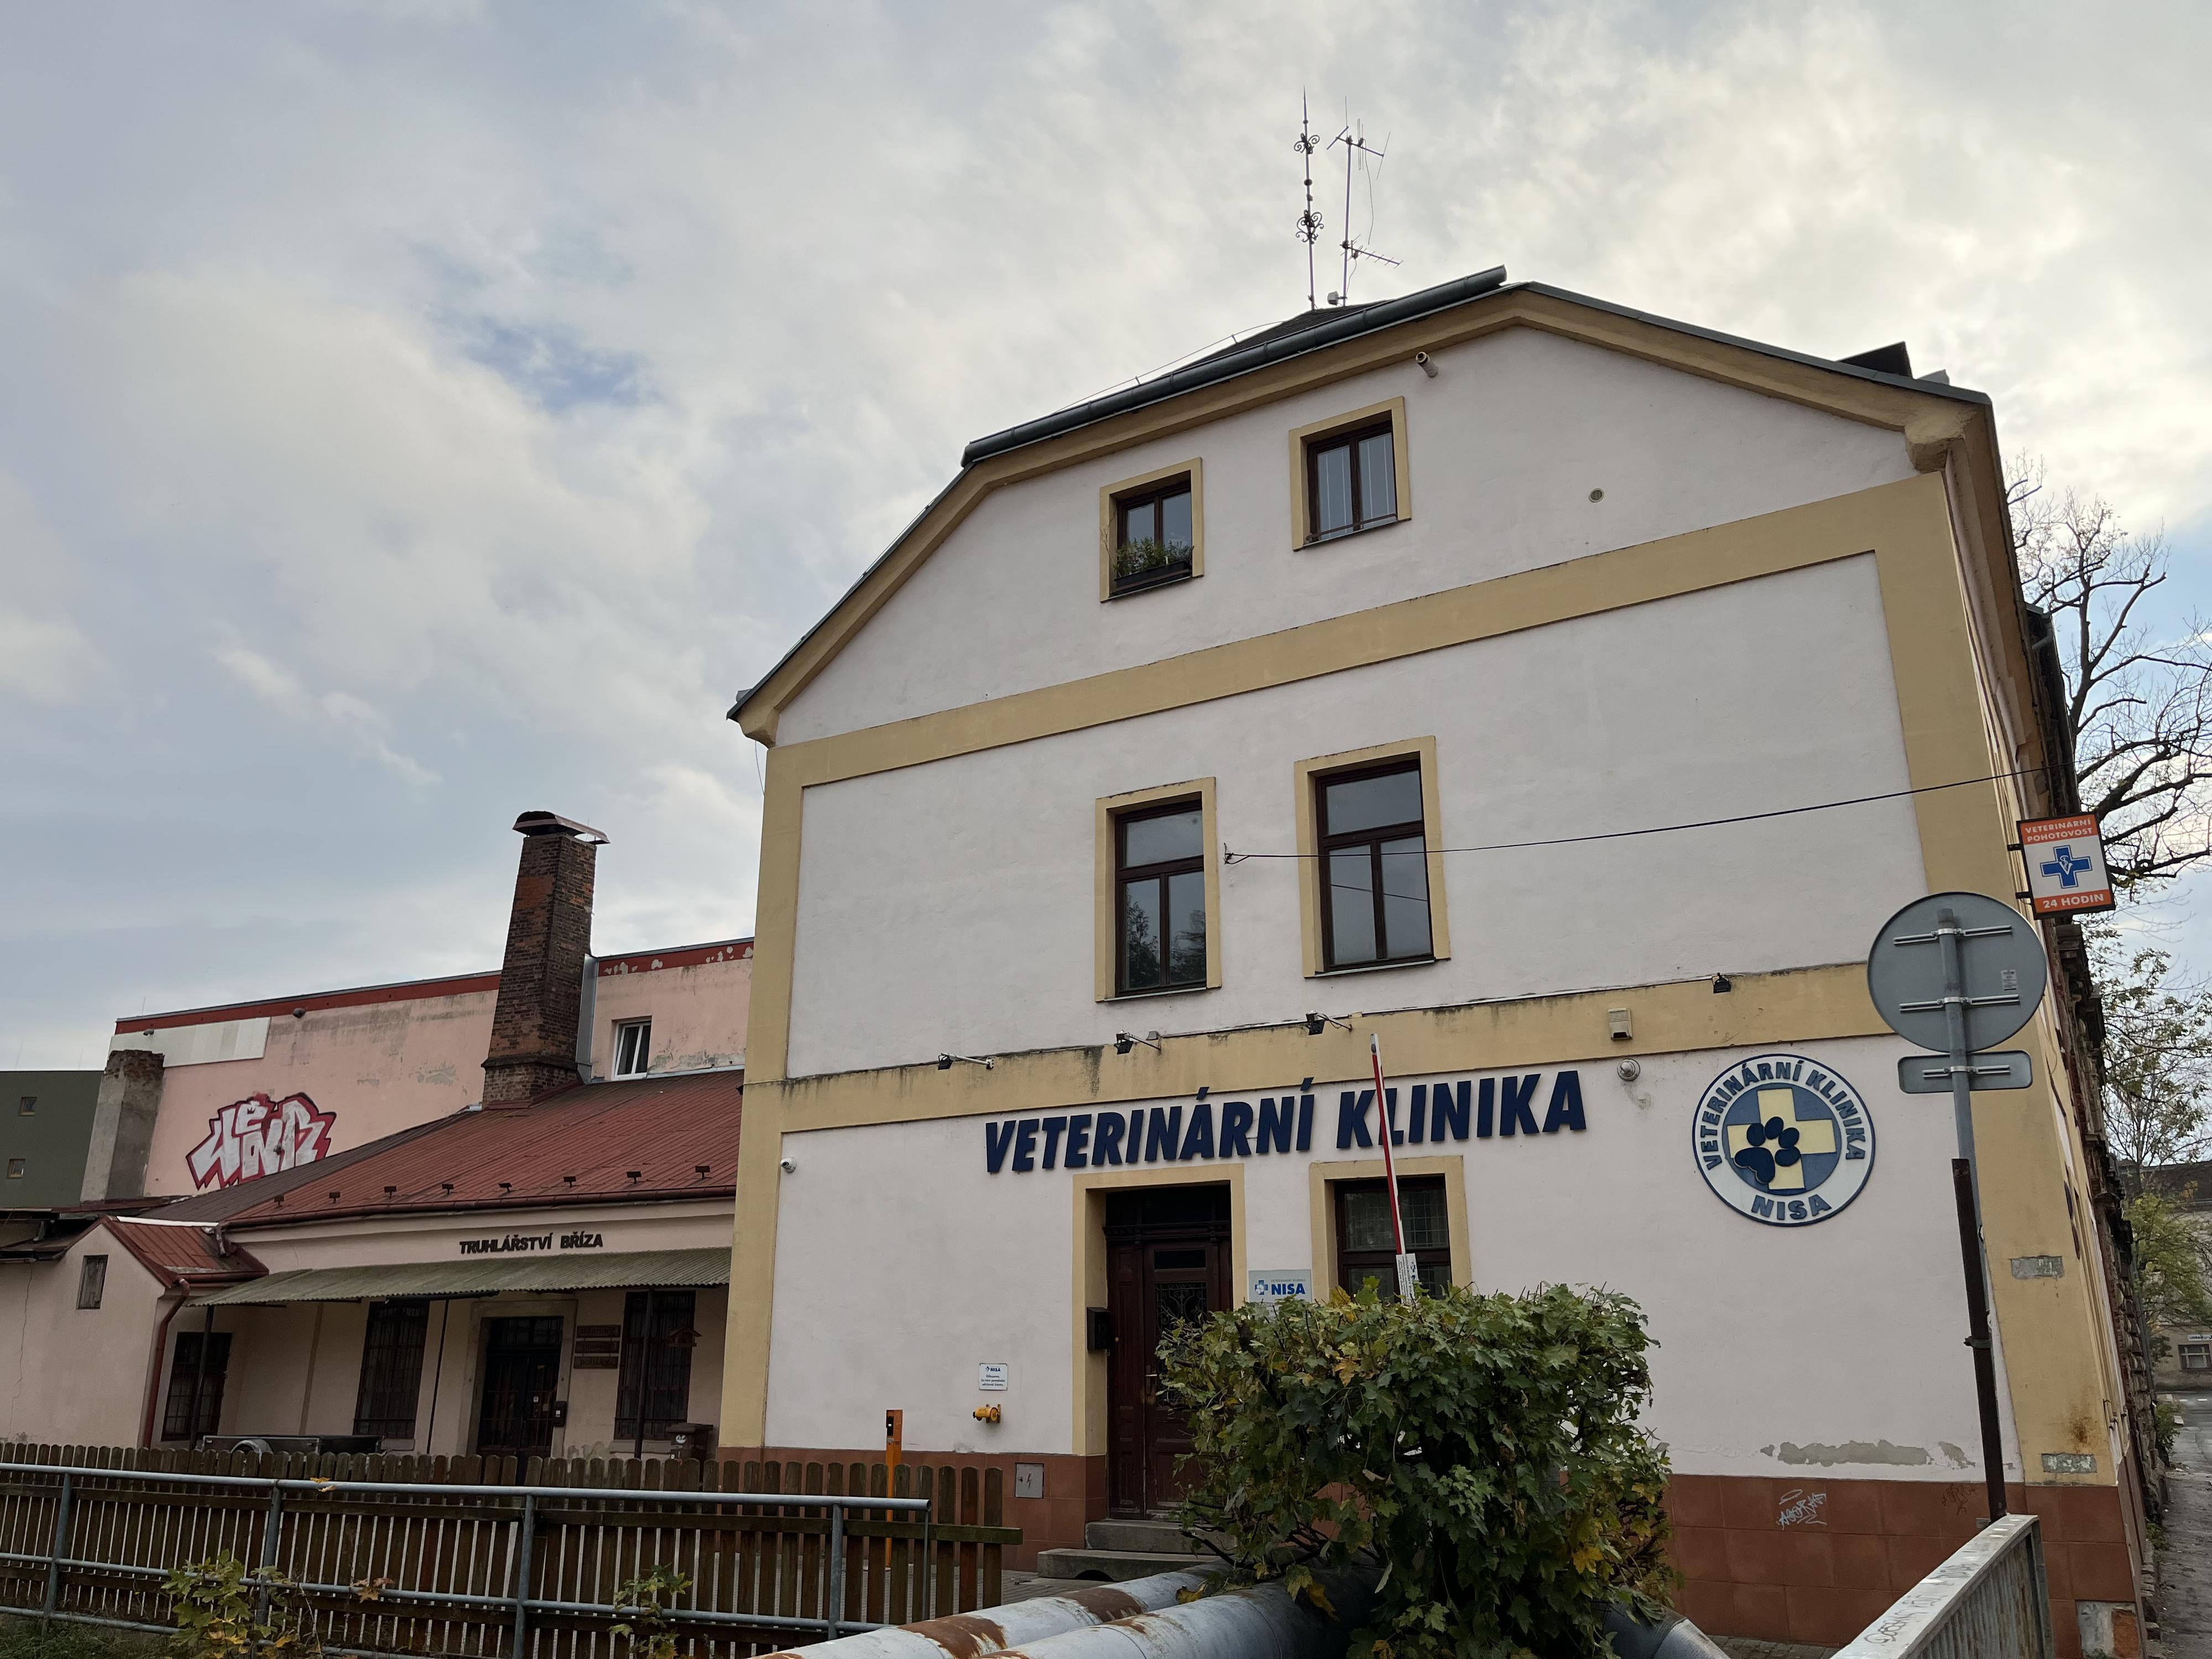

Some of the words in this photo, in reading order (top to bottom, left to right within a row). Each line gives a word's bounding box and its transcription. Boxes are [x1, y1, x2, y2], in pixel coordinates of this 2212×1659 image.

[2025, 817, 2091, 834] VETERINÁRNÍ
[2027, 827, 2093, 842] POHOTOVOST
[2043, 899, 2058, 909] 24
[2061, 894, 2104, 906] HODIN
[985, 1076, 1314, 1173] VETERINÁRNÍ
[1335, 1070, 1587, 1149] KLINIKA
[1700, 1059, 1804, 1170] VETERINÁRNÍ
[1805, 1069, 1866, 1160] KLINIKA
[1750, 1193, 1832, 1220] NISA
[459, 1233, 554, 1254] TRUHLÁŘSTVÍ
[560, 1230, 604, 1249] BŘÍZA
[1271, 1282, 1306, 1295] NISA
